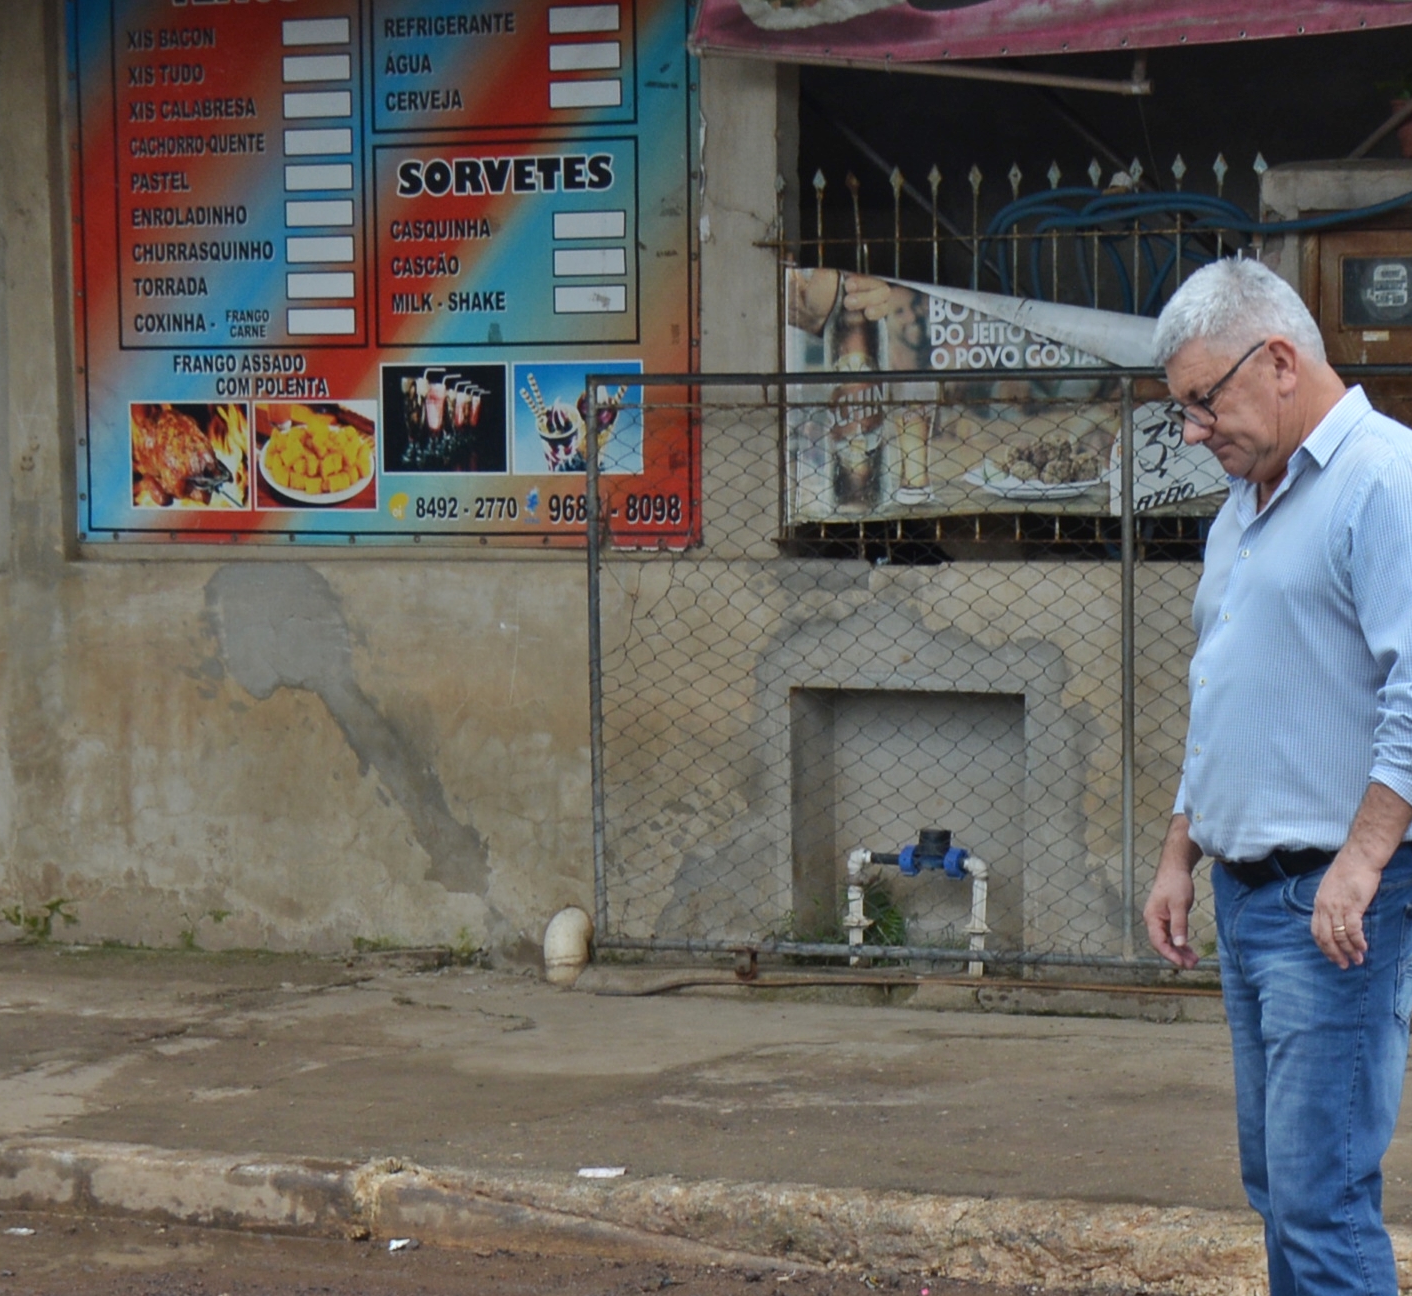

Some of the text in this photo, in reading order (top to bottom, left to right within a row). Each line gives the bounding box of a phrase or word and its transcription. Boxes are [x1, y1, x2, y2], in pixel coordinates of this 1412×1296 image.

[384, 12, 516, 38] REFRIGERANTE
[127, 28, 216, 50] XIS BACON
[128, 64, 205, 86] XIS TUDO
[385, 52, 432, 75] ÁGUA
[129, 98, 257, 122] XIS CALABRESA
[385, 89, 464, 112] CERVEJA
[130, 133, 266, 158] CACHORRO-QUENTE
[131, 171, 191, 193] PASTEL
[397, 153, 614, 197] SORVETES
[132, 206, 248, 229] ENROLADINHO
[390, 218, 492, 243] CASQUINHA
[132, 241, 275, 265] CHURRASQUINHO
[391, 253, 461, 278] CASCÃO
[133, 277, 209, 298] TORRADA
[391, 293, 433, 314] MILK
[447, 291, 507, 313] SHAKE
[134, 313, 207, 335] COXINHA
[225, 309, 271, 324] FRANGO
[230, 325, 267, 339] CARNE
[930, 323, 964, 346] DO
[968, 322, 1026, 345] JEITO
[173, 354, 306, 375] FRANGO ASSADO
[930, 347, 950, 370] O
[955, 345, 1019, 369] POVO
[216, 377, 330, 398] COM POLENTA
[1136, 478, 1195, 511] ATÃO
[416, 496, 459, 521] 8492
[475, 496, 519, 521] 2770
[549, 494, 601, 525] 968
[625, 494, 682, 525] 8098
